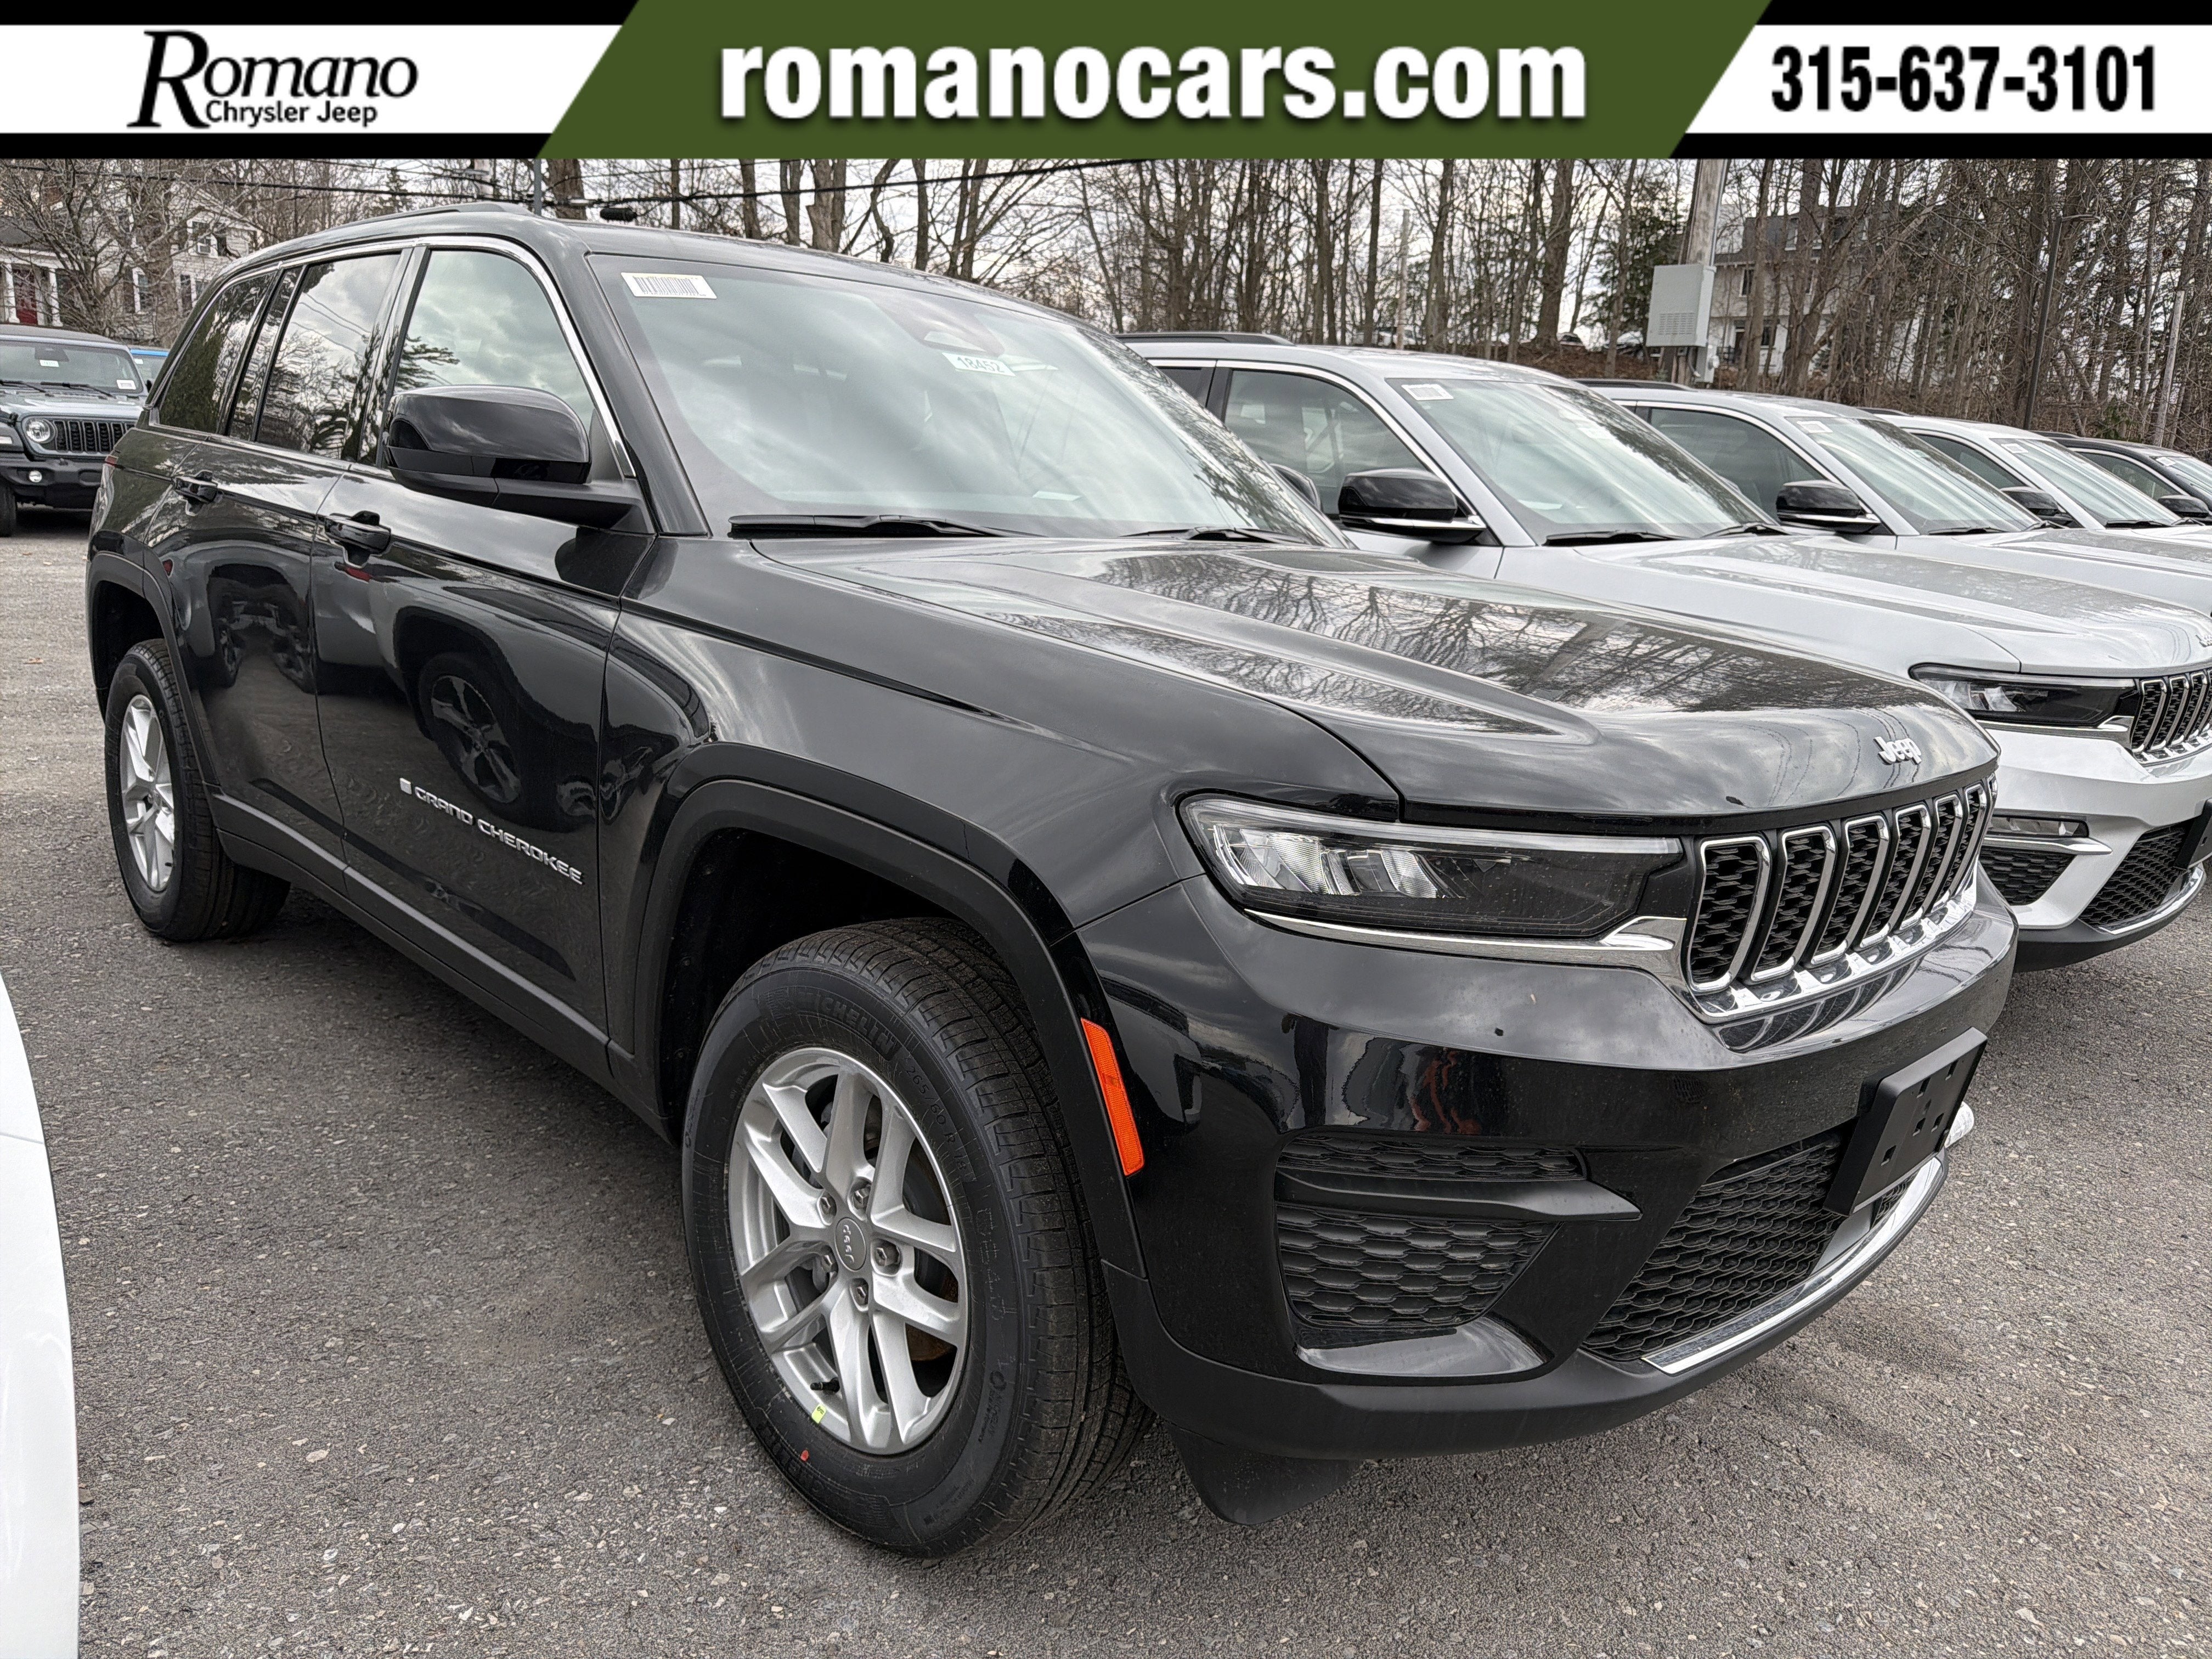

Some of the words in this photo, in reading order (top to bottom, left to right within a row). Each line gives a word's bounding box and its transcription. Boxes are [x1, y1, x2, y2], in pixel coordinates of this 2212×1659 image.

[1873, 736, 1922, 765] Jeep
[414, 786, 473, 825] GRAND
[477, 819, 585, 885] CHEROKEE
[797, 992, 898, 1054] ICHELIN
[843, 1224, 855, 1263] Jeep
